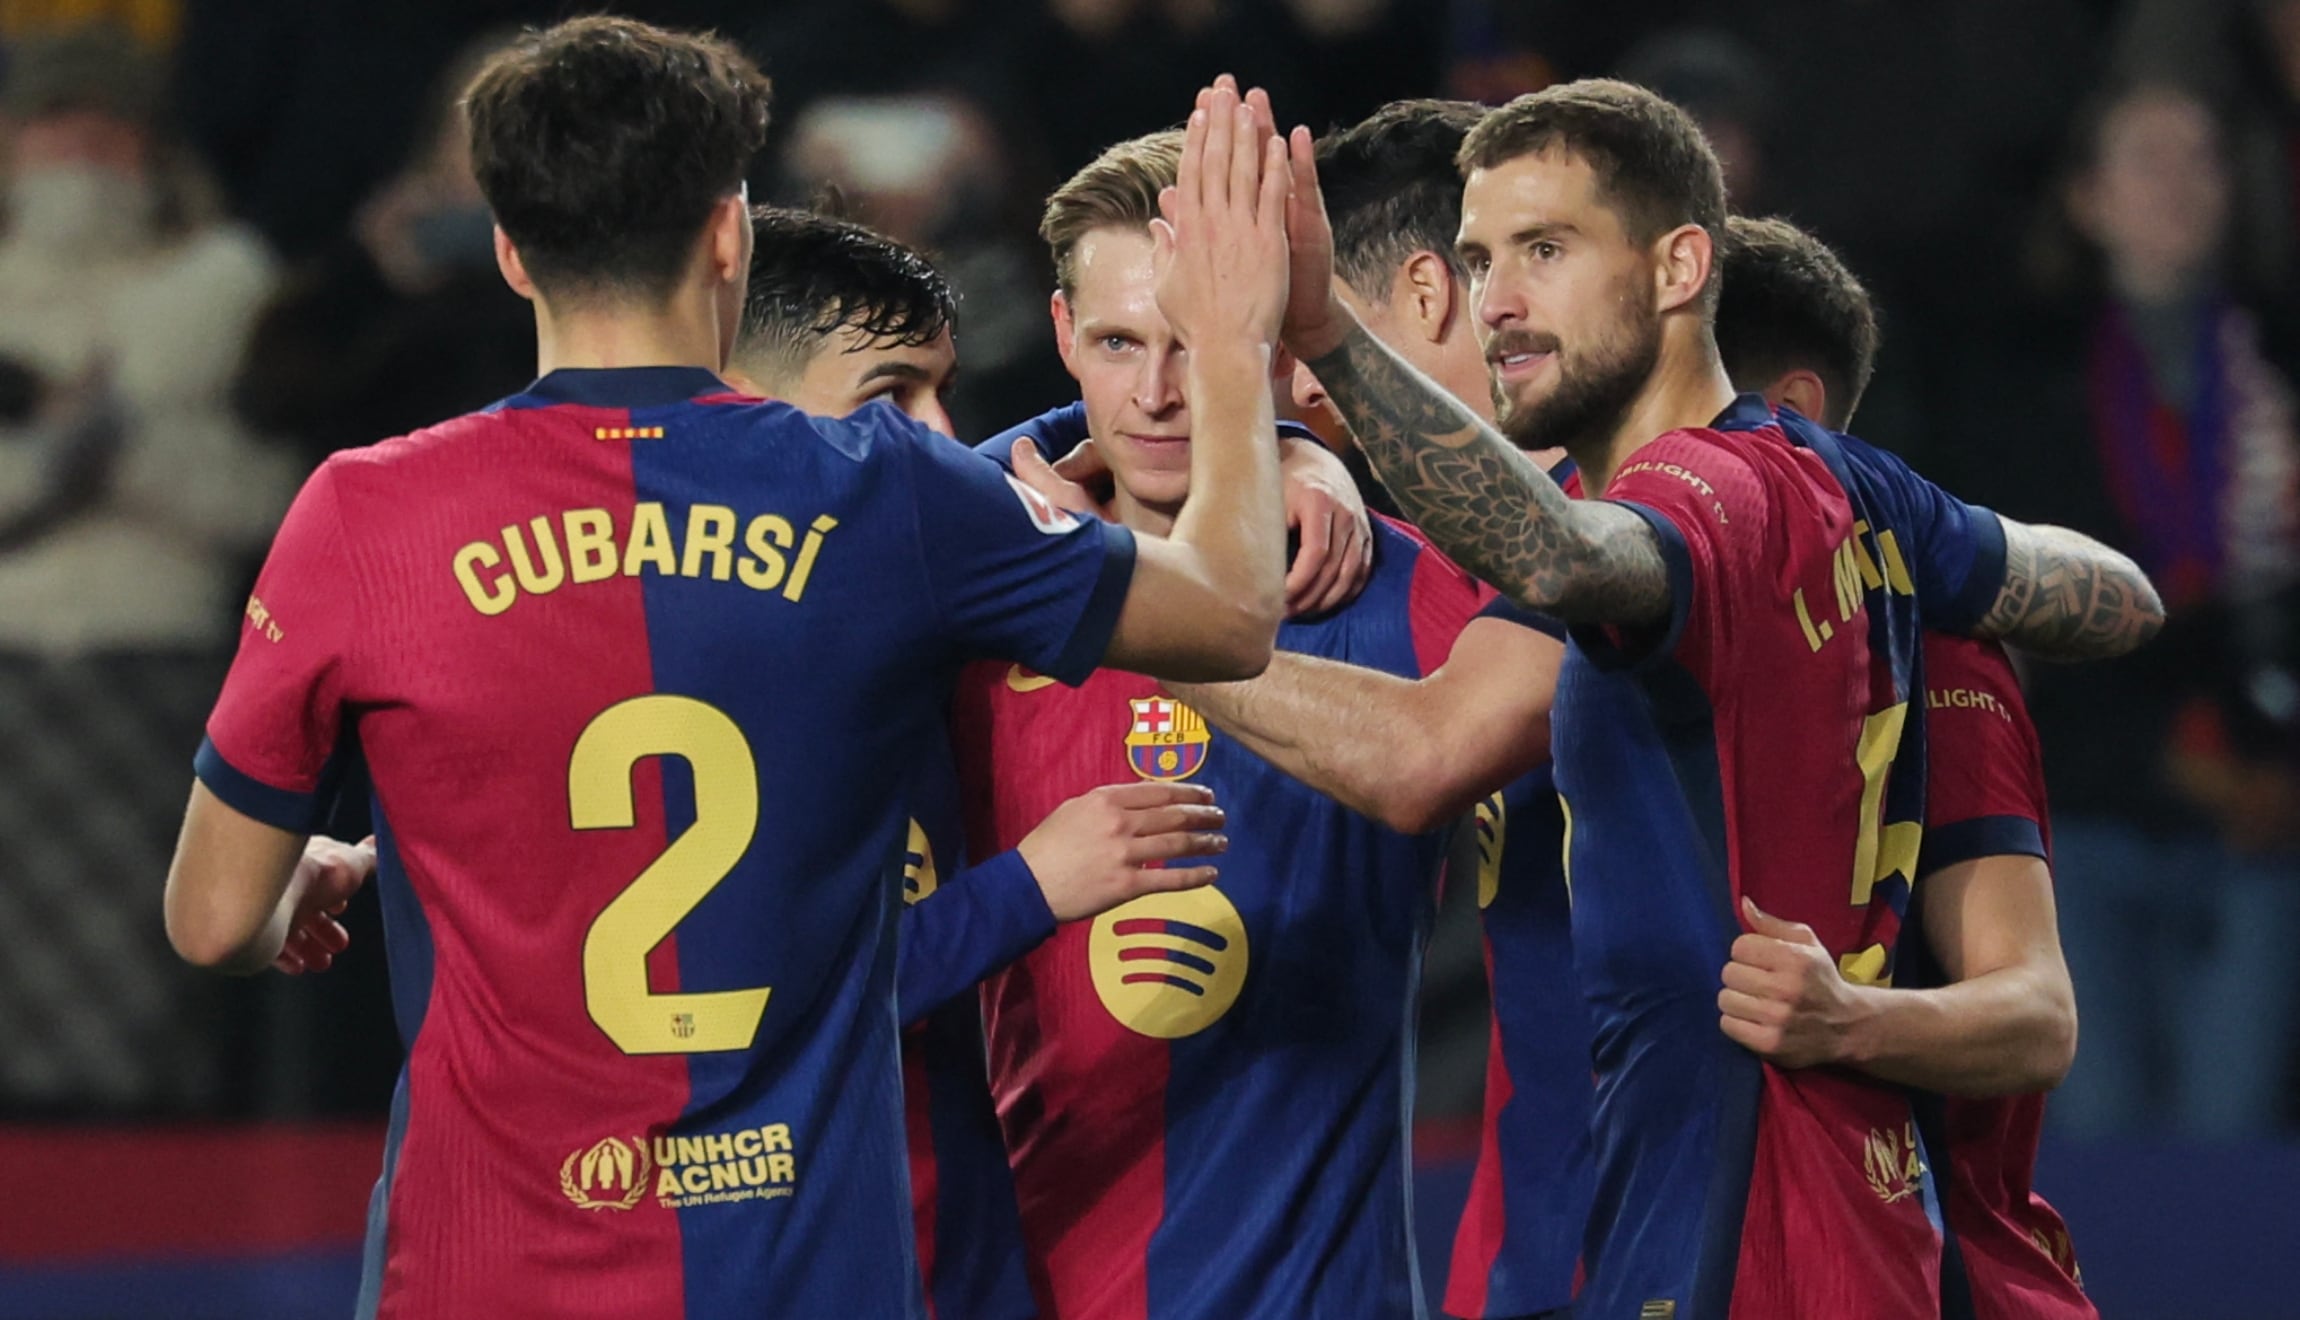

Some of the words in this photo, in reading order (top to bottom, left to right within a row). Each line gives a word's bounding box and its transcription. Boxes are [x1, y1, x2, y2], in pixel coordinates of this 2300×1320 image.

[452, 501, 839, 616] CUBARSÍ
[567, 694, 772, 1055] 2
[654, 1123, 793, 1167] UNHCR
[656, 1153, 795, 1197] ACNUR
[659, 1197, 682, 1209] The
[684, 1195, 703, 1207] UN
[704, 1190, 753, 1206] Refugee
[755, 1185, 794, 1200] Agency
